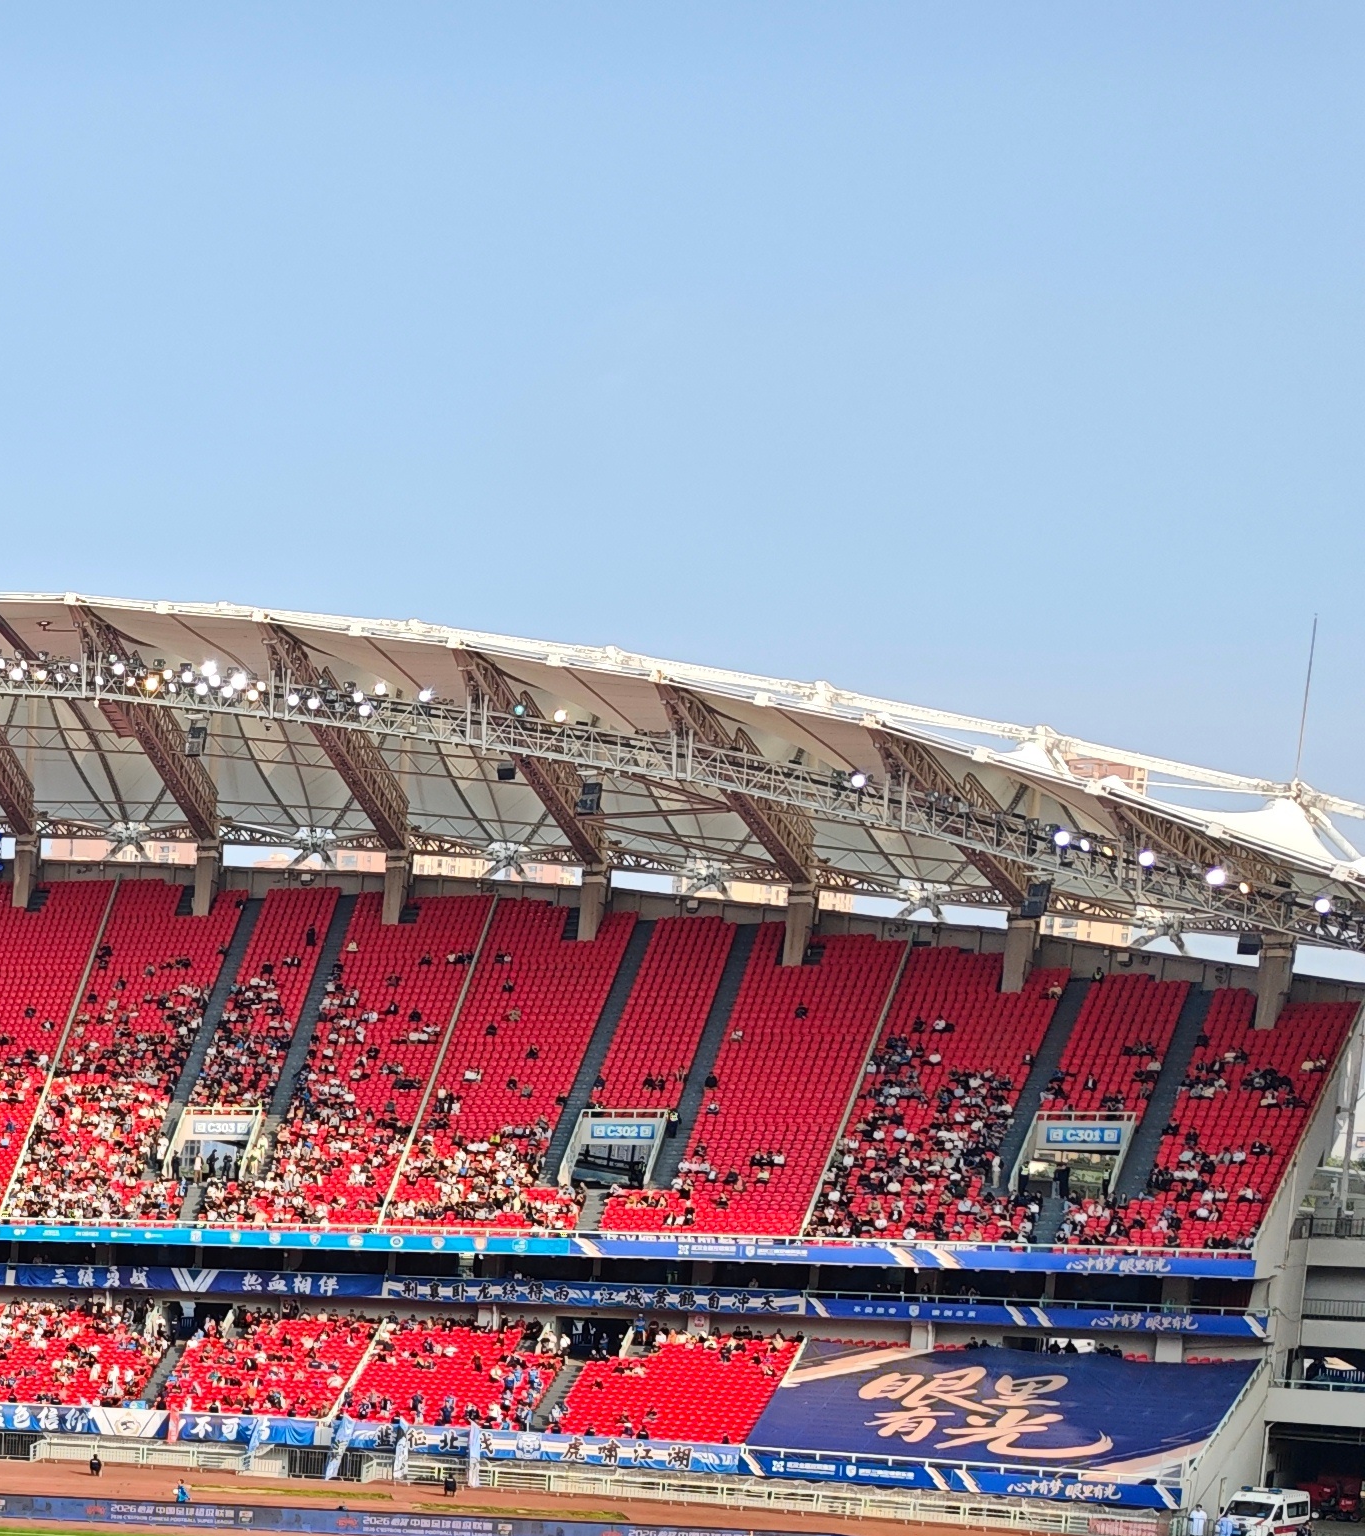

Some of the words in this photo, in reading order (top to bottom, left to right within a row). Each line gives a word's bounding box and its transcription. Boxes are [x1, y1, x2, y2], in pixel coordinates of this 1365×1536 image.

[207, 1122, 235, 1132] C303
[607, 1125, 638, 1136] C302
[1066, 1130, 1101, 1141] C301
[51, 1266, 148, 1288] 三镇勇战
[242, 1272, 340, 1296] 热血相伴
[599, 1288, 778, 1312] 江城黄鹤自冲天
[563, 1436, 694, 1469] 虎啸江湖
[111, 1504, 136, 1513] 2026
[363, 1516, 390, 1525] 2026
